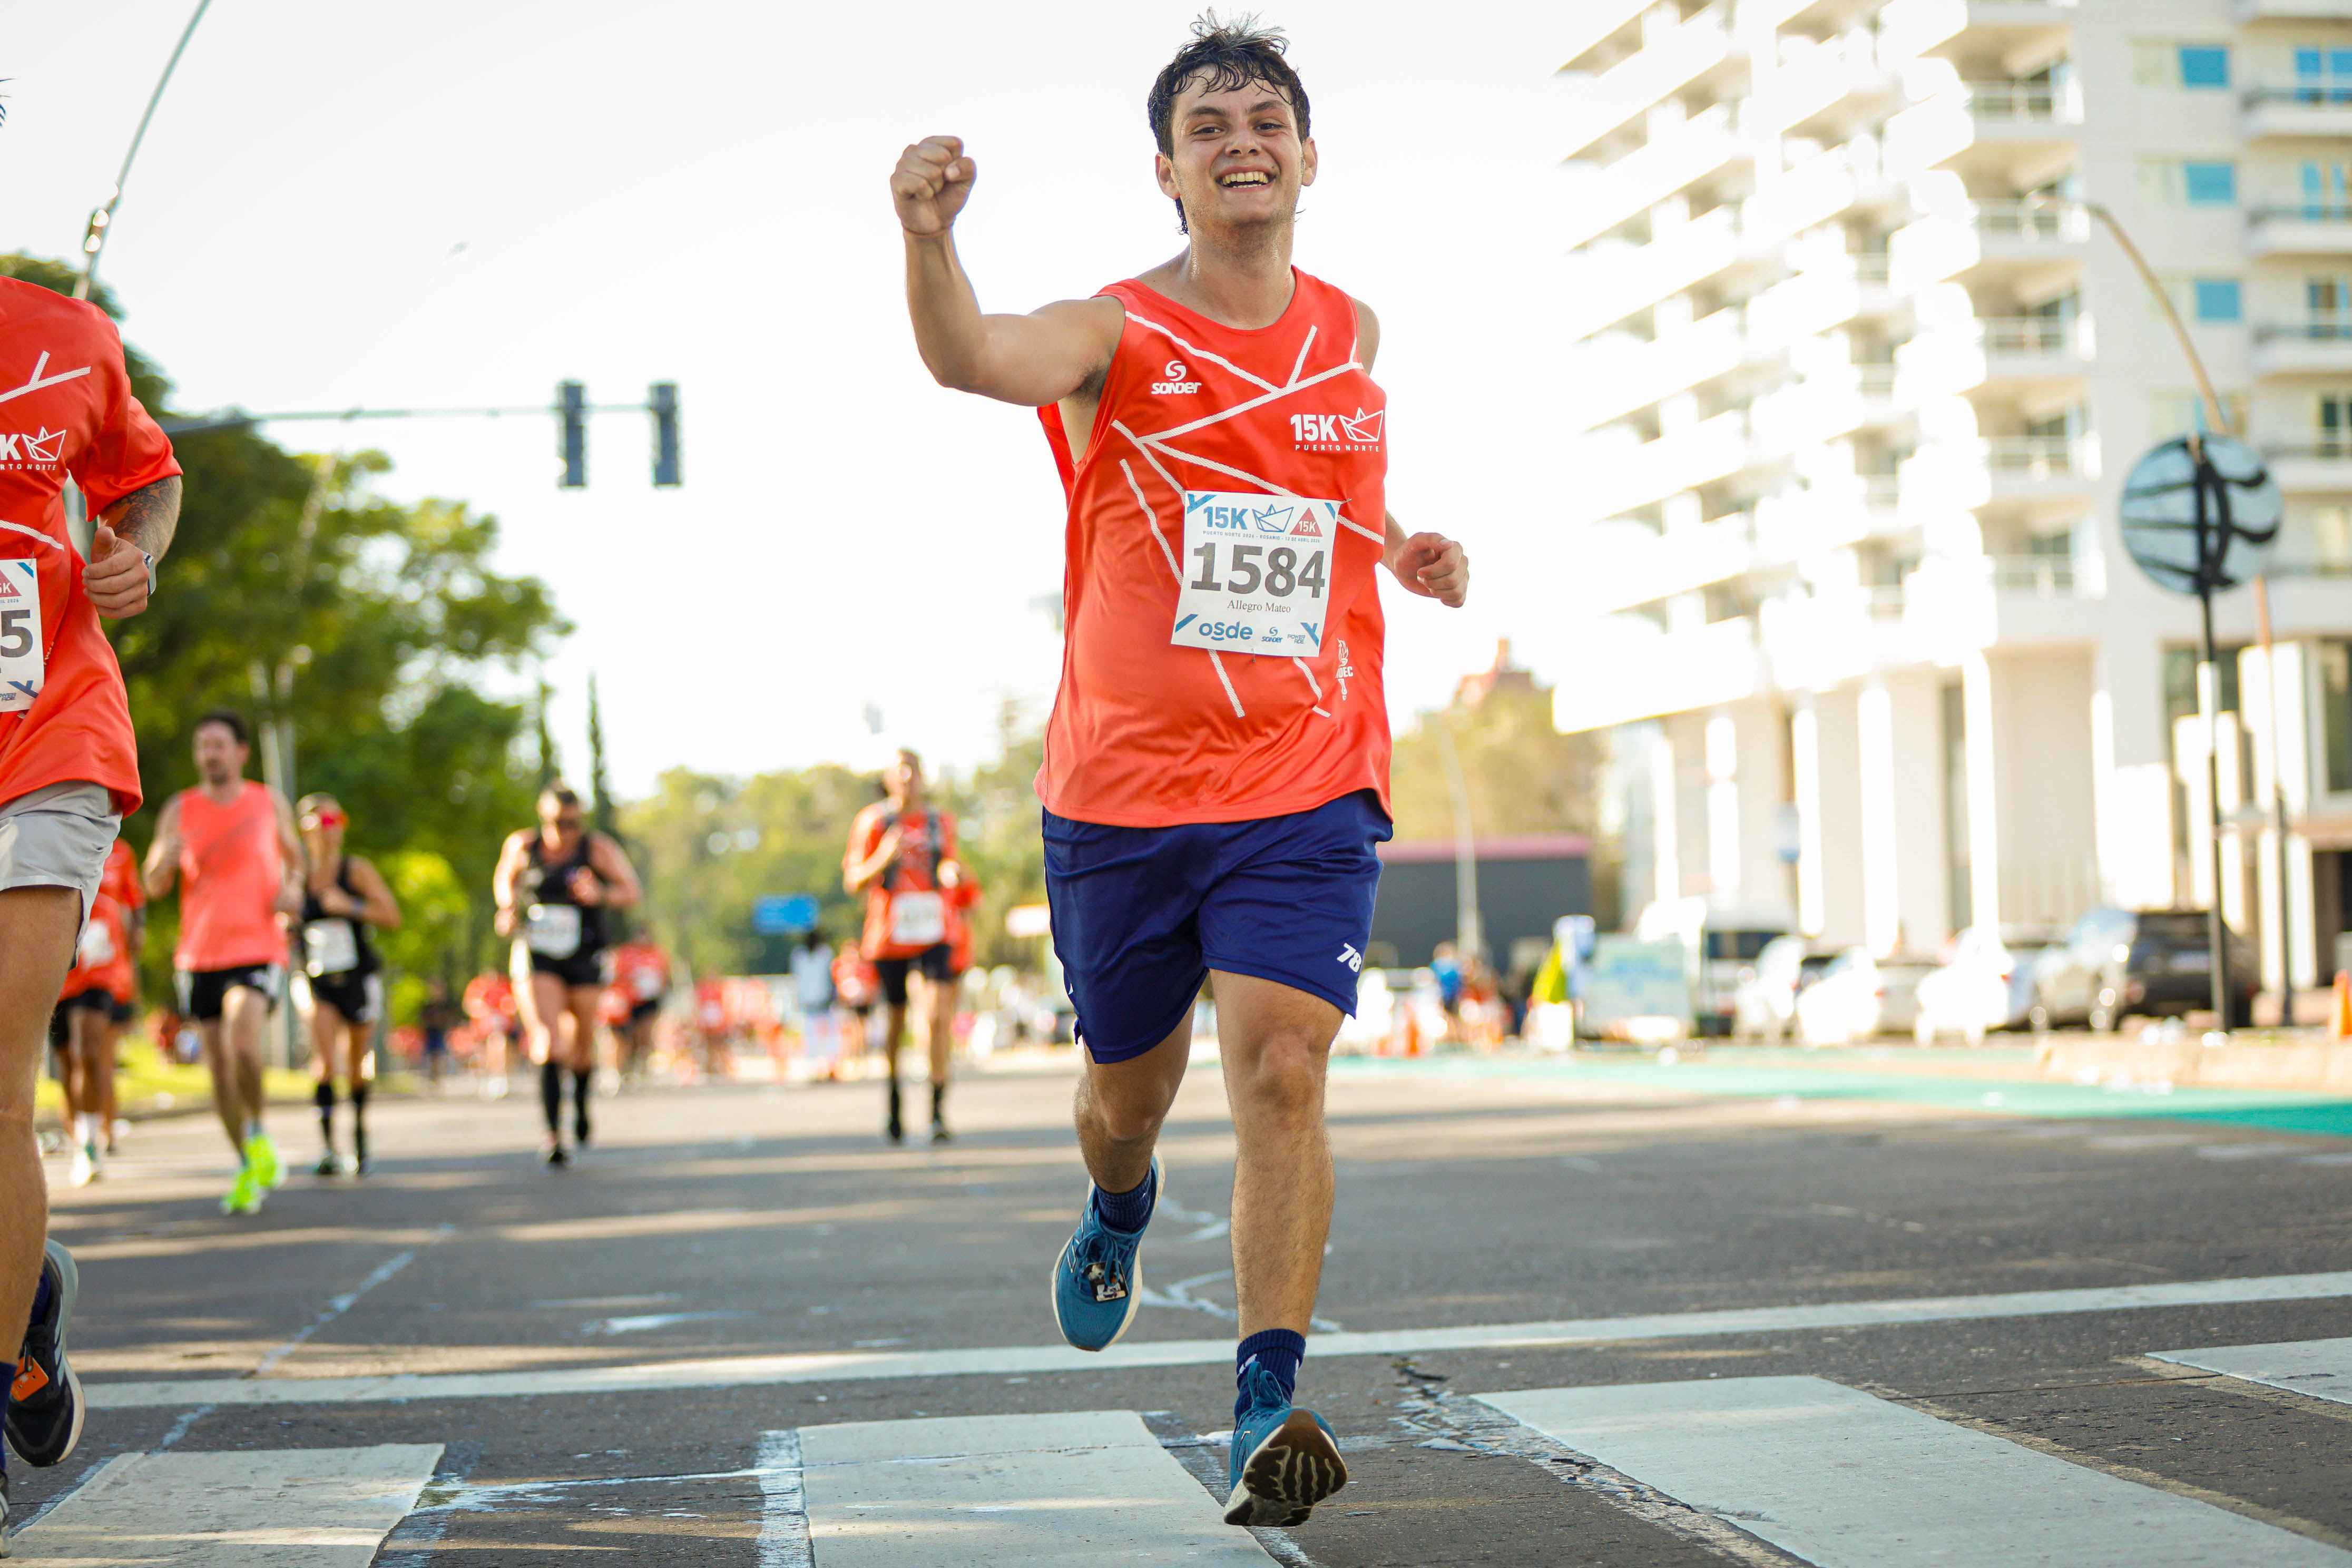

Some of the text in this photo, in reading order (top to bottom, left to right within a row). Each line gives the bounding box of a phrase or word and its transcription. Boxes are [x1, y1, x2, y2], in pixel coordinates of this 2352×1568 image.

[1290, 414, 1339, 441] 15K
[1203, 506, 1248, 530] 15K
[1298, 521, 1316, 533] 15K
[1191, 542, 1325, 599] 1584
[1227, 600, 1291, 613] Allegro Mateo
[1199, 621, 1253, 641] osde
[1337, 942, 1362, 973] 78
